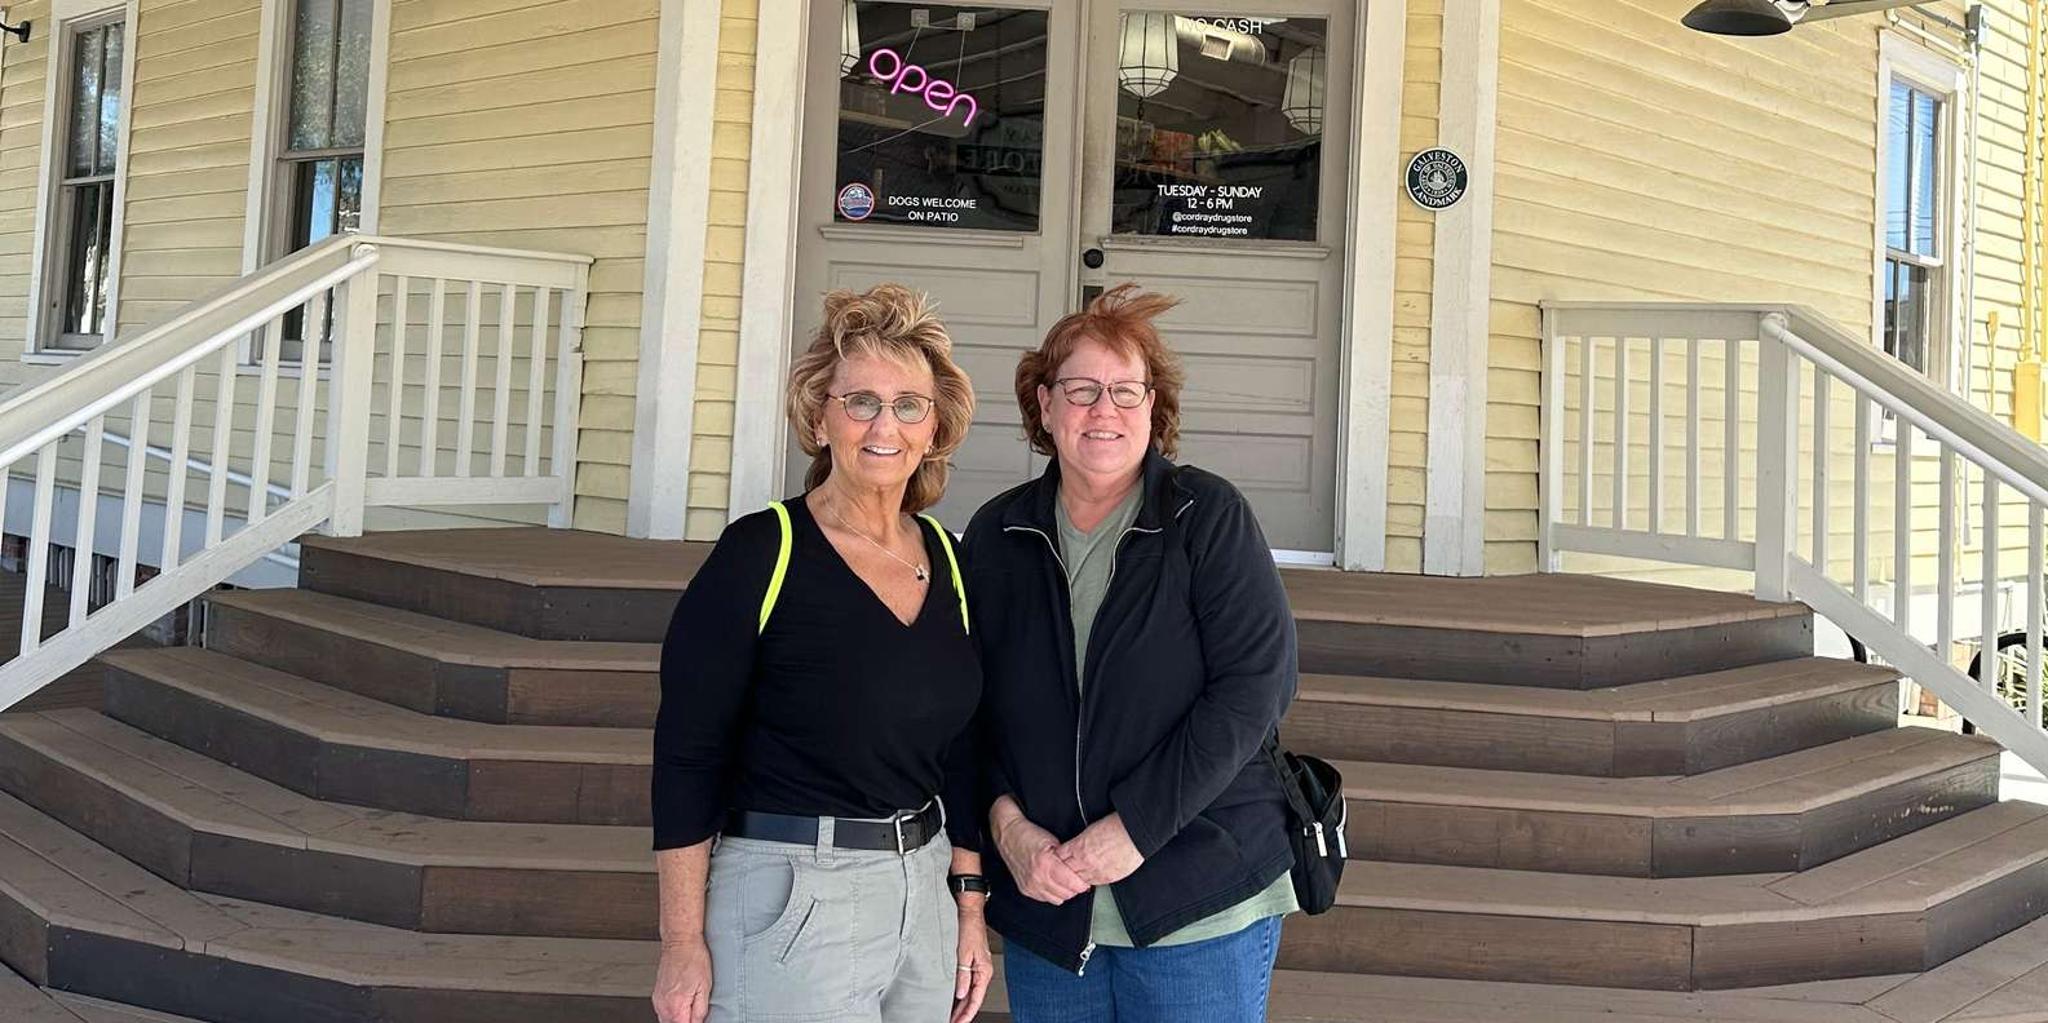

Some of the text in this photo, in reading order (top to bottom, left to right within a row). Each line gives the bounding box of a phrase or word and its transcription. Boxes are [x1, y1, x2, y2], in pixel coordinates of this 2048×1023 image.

[1213, 18, 1262, 35] CASH
[870, 48, 977, 127] open
[1413, 152, 1464, 173] GALVESTON
[1157, 184, 1208, 197] TUESDAY
[1217, 186, 1263, 198] SUNDAY
[1412, 186, 1462, 206] LANDMARK
[888, 195, 977, 209] DOGS WELCOME
[1187, 198, 1198, 209] 12
[1206, 198, 1214, 209] 6
[1215, 198, 1234, 209] PM
[908, 210, 959, 222] ON PATIO
[1172, 211, 1253, 224] @cordraydrugstore
[1171, 224, 1248, 236] #cordraydrugstore
